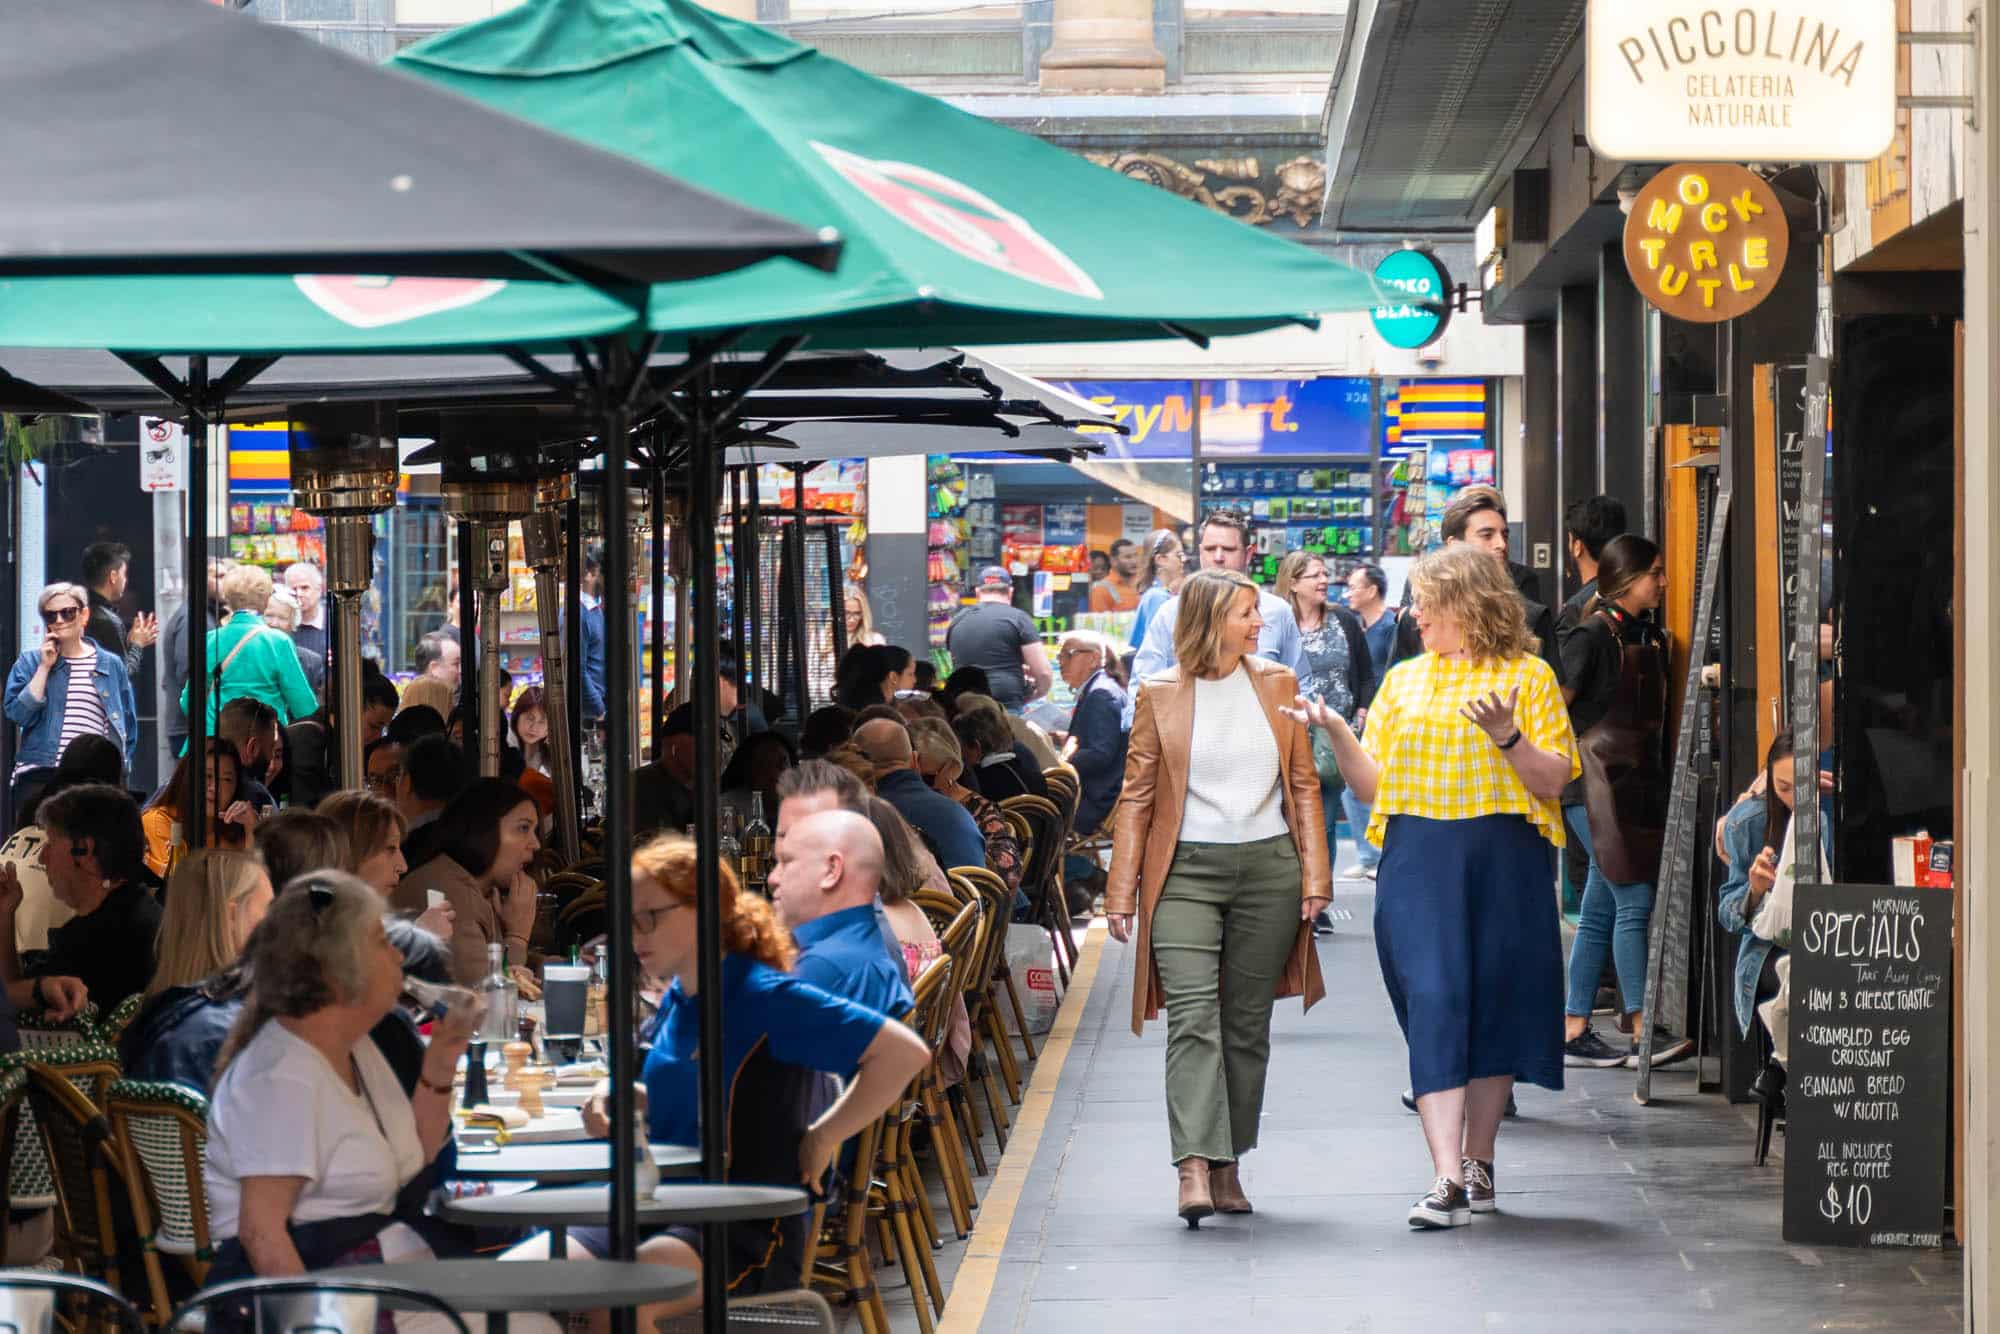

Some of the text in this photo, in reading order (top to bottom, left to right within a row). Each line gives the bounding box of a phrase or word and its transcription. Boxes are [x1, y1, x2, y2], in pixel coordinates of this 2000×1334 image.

[1618, 8, 1864, 87] PICCOLINA
[1686, 73, 1794, 98] GELATERIA
[1688, 103, 1793, 128] NATURALE
[1647, 174, 1763, 234] MOCK
[1872, 898, 1920, 916] MORNING
[1803, 910, 1925, 962] SPECIALS
[1809, 987, 1833, 1011] HAM
[1855, 991, 1895, 1011] CHEESE
[1897, 987, 1936, 1010] TOASTIE
[1806, 1026, 1911, 1047] SCRAMBLED EGG
[1831, 1049, 1895, 1067] CROISSANT
[1803, 1075, 1905, 1097] BANANA BREAD
[1853, 1101, 1900, 1120] RICOTTA
[1817, 1142, 1893, 1161] ALL INCLUDES
[1853, 1161, 1891, 1179] COFFEE
[1819, 1181, 1872, 1225] $10
